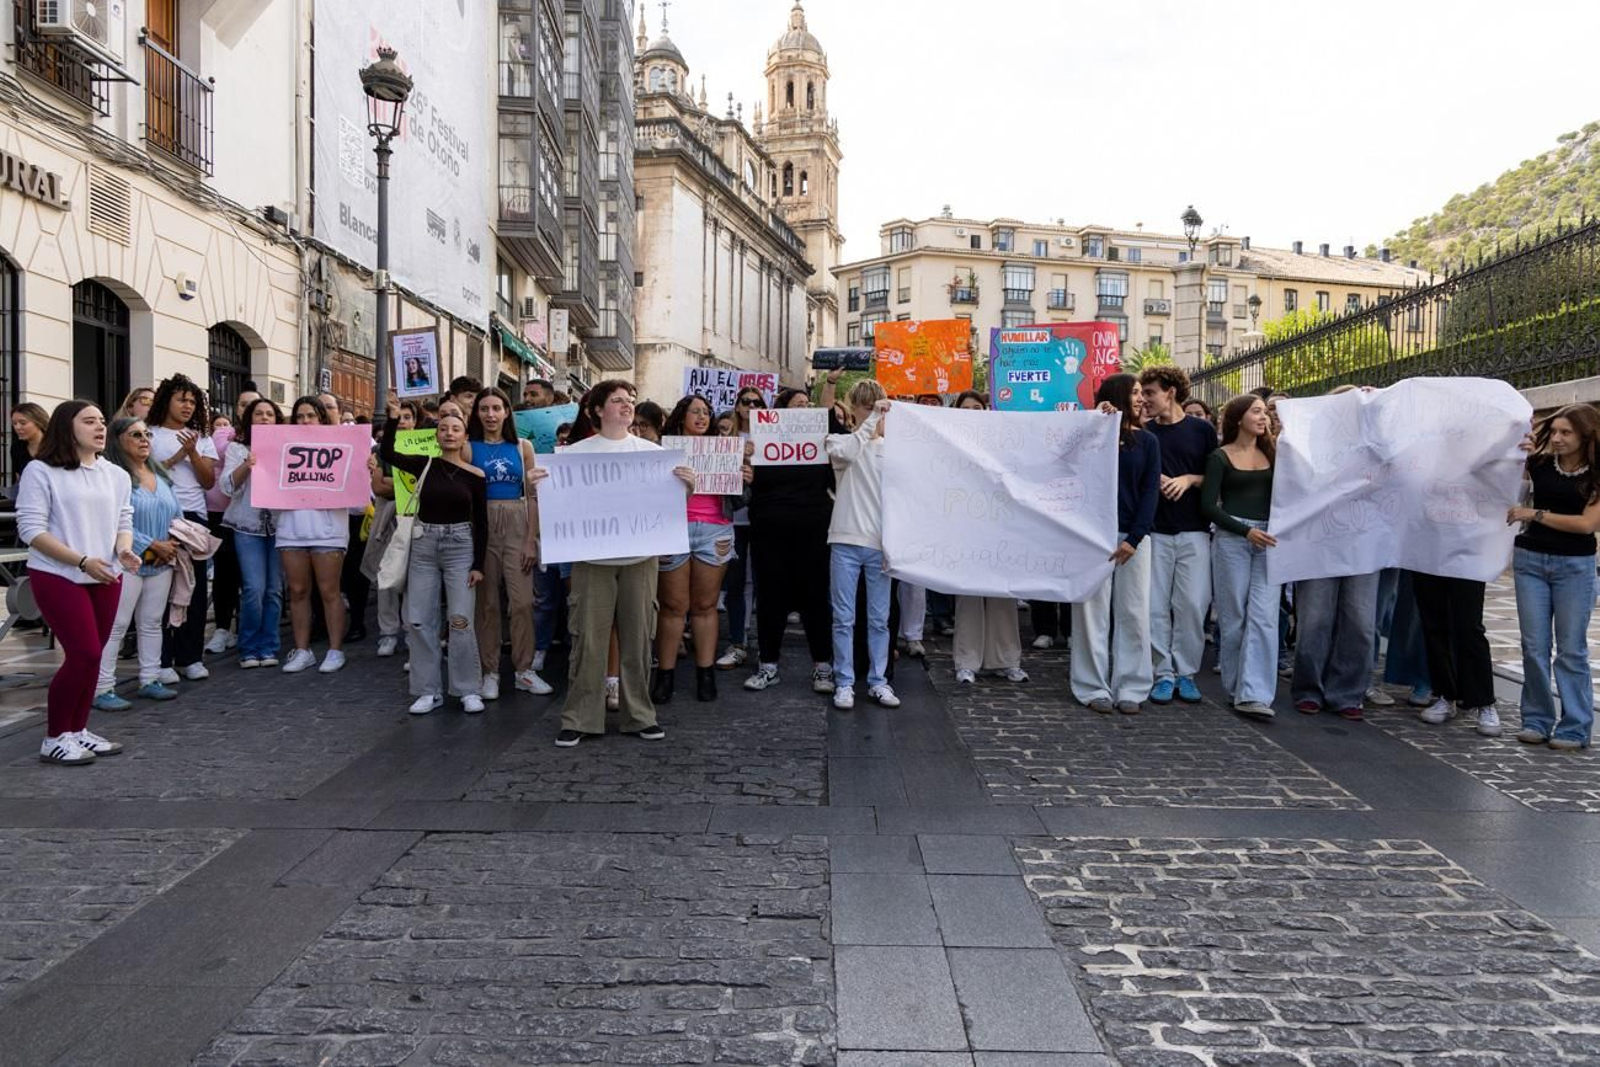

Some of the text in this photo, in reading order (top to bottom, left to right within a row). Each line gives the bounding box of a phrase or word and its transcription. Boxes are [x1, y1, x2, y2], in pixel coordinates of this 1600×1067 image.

[410, 113, 460, 177] de Otoño
[431, 104, 470, 163] Festival
[1001, 331, 1048, 342] HUMILLAR
[1008, 371, 1049, 382] FUERTE
[757, 411, 779, 424] NO
[287, 446, 343, 469] STOP
[764, 442, 818, 461] ODIO
[581, 461, 621, 486] UNA
[944, 488, 1014, 521] POR
[554, 520, 575, 541] NI
[582, 516, 620, 539] UNA
